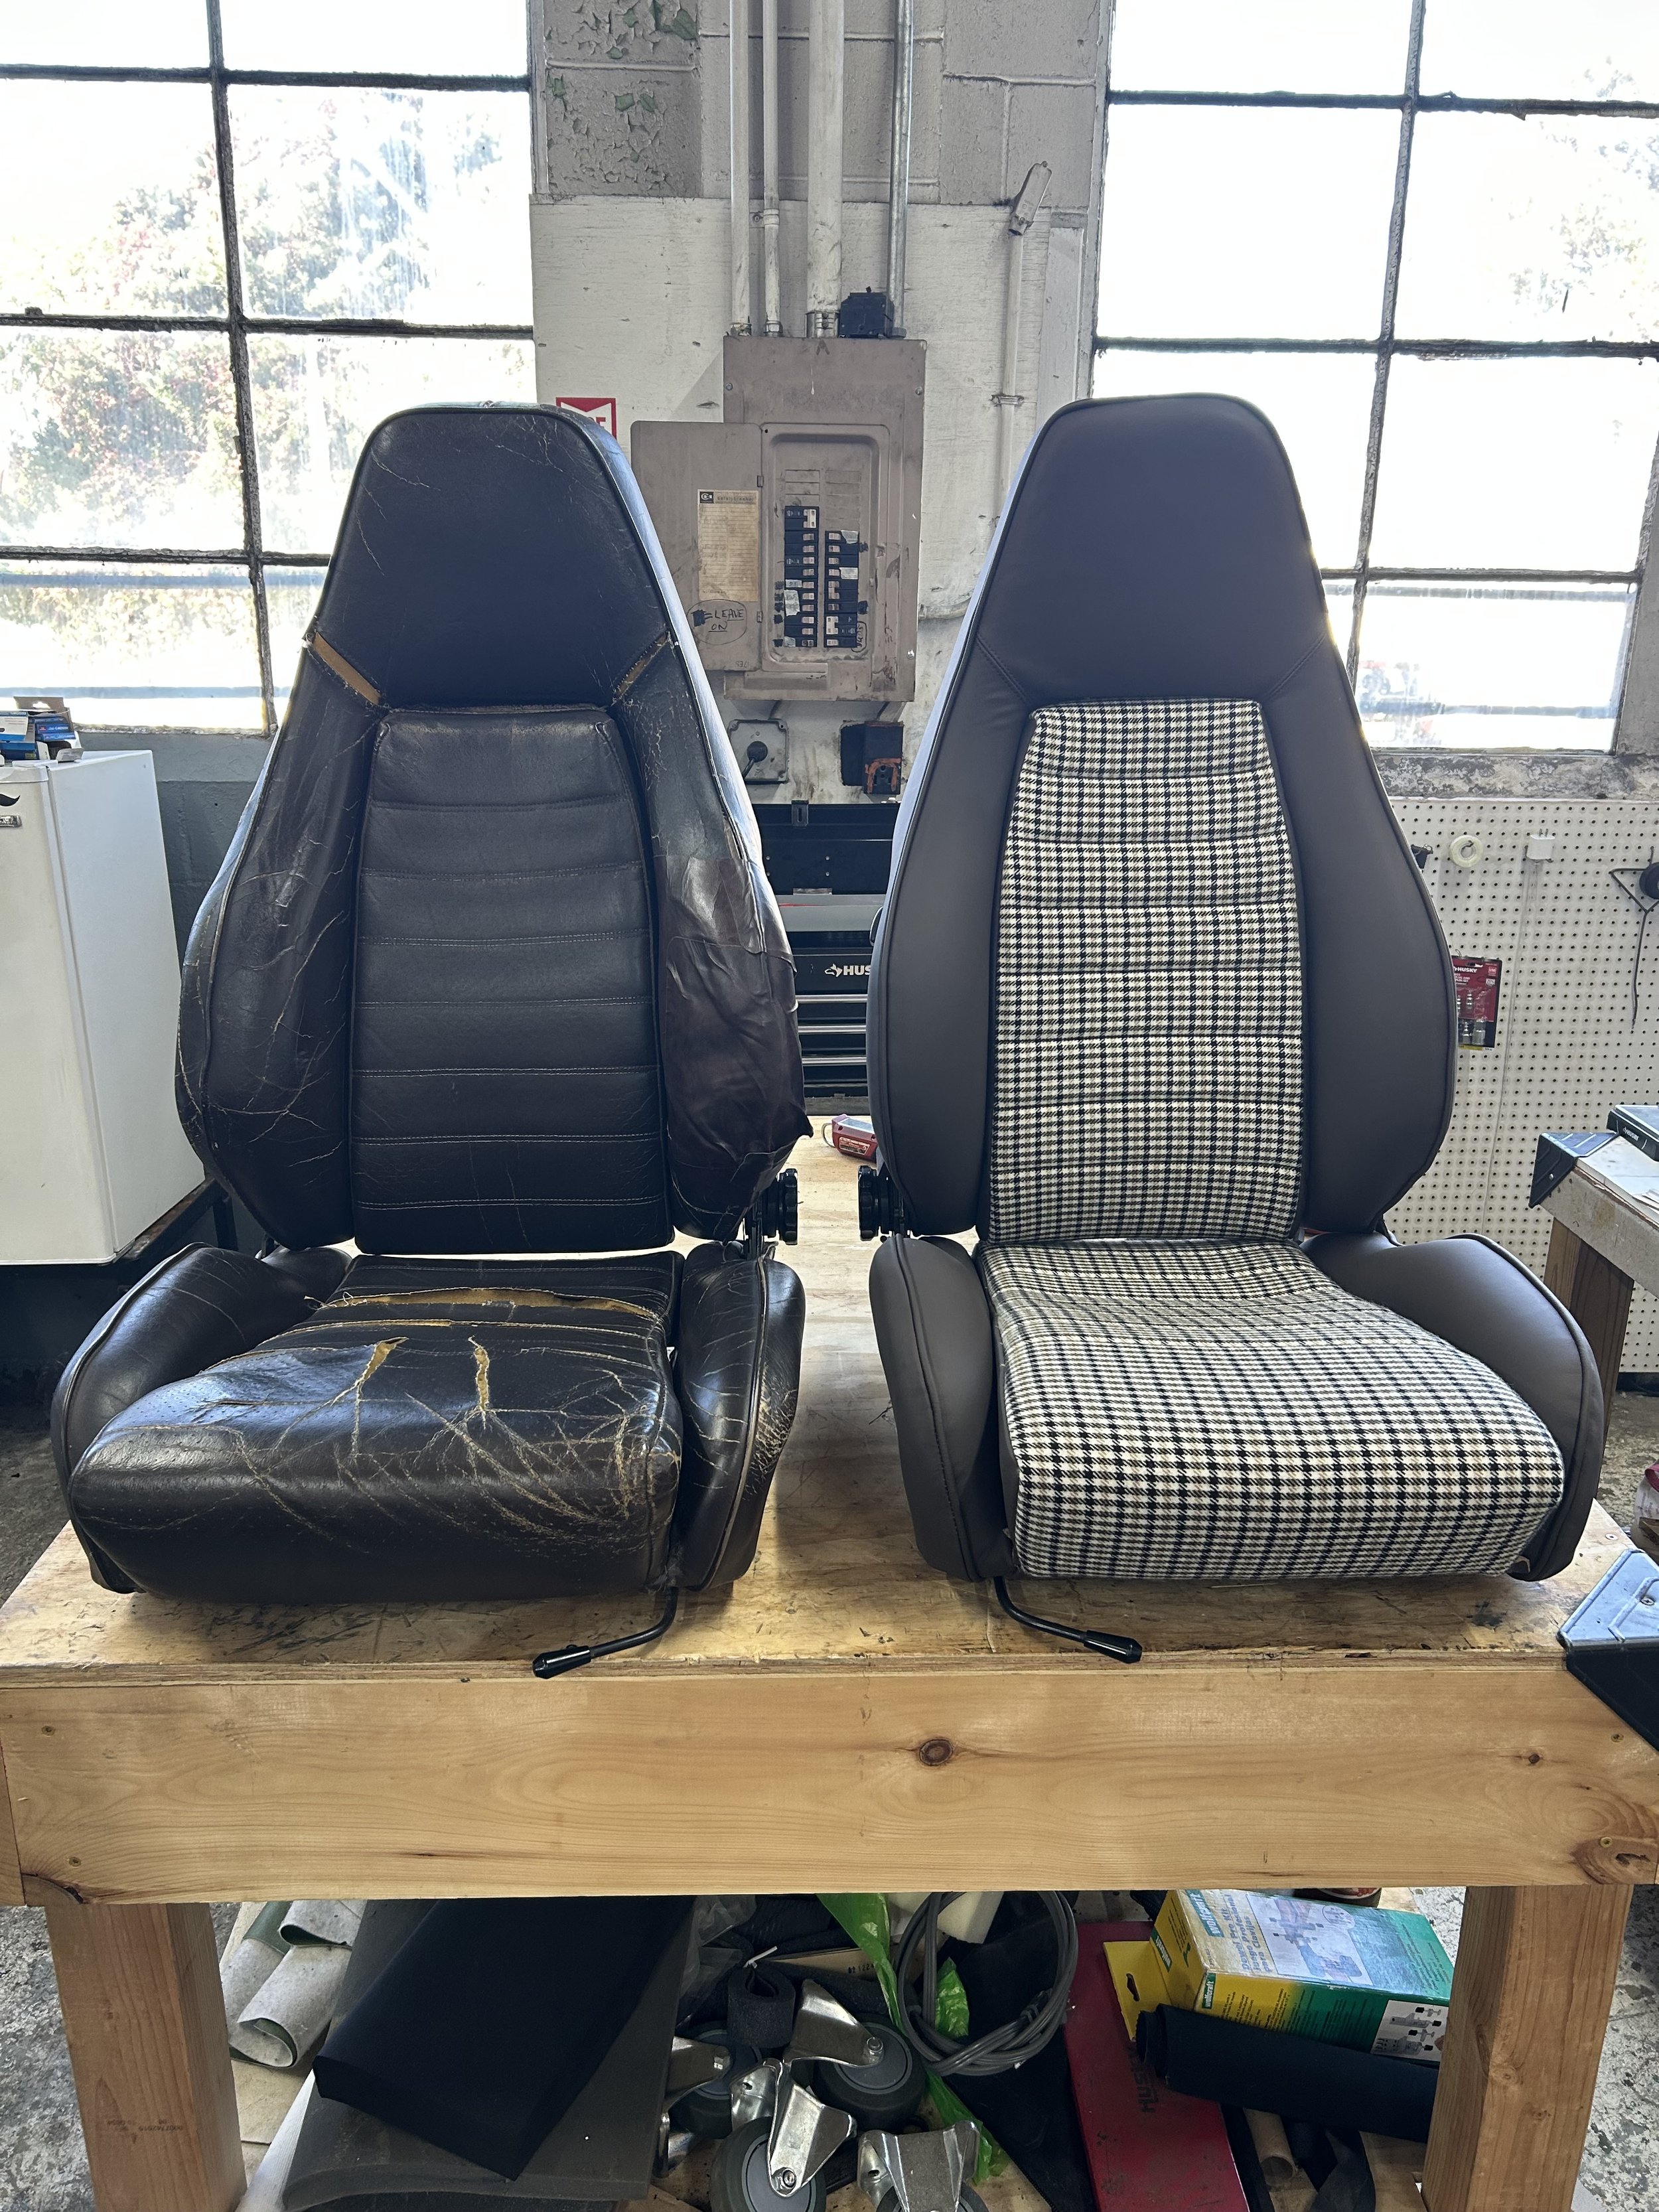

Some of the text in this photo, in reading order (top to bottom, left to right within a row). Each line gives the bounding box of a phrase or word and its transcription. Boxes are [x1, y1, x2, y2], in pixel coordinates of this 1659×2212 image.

[715, 609, 744, 619] LEAVE
[711, 621, 727, 630] ON
[843, 965, 871, 976] HUS
[1190, 1893, 1221, 1935] wolfcraft
[1221, 1907, 1250, 1970] Dowel Pro Kit
[1204, 1980, 1214, 2008] wolfcraft
